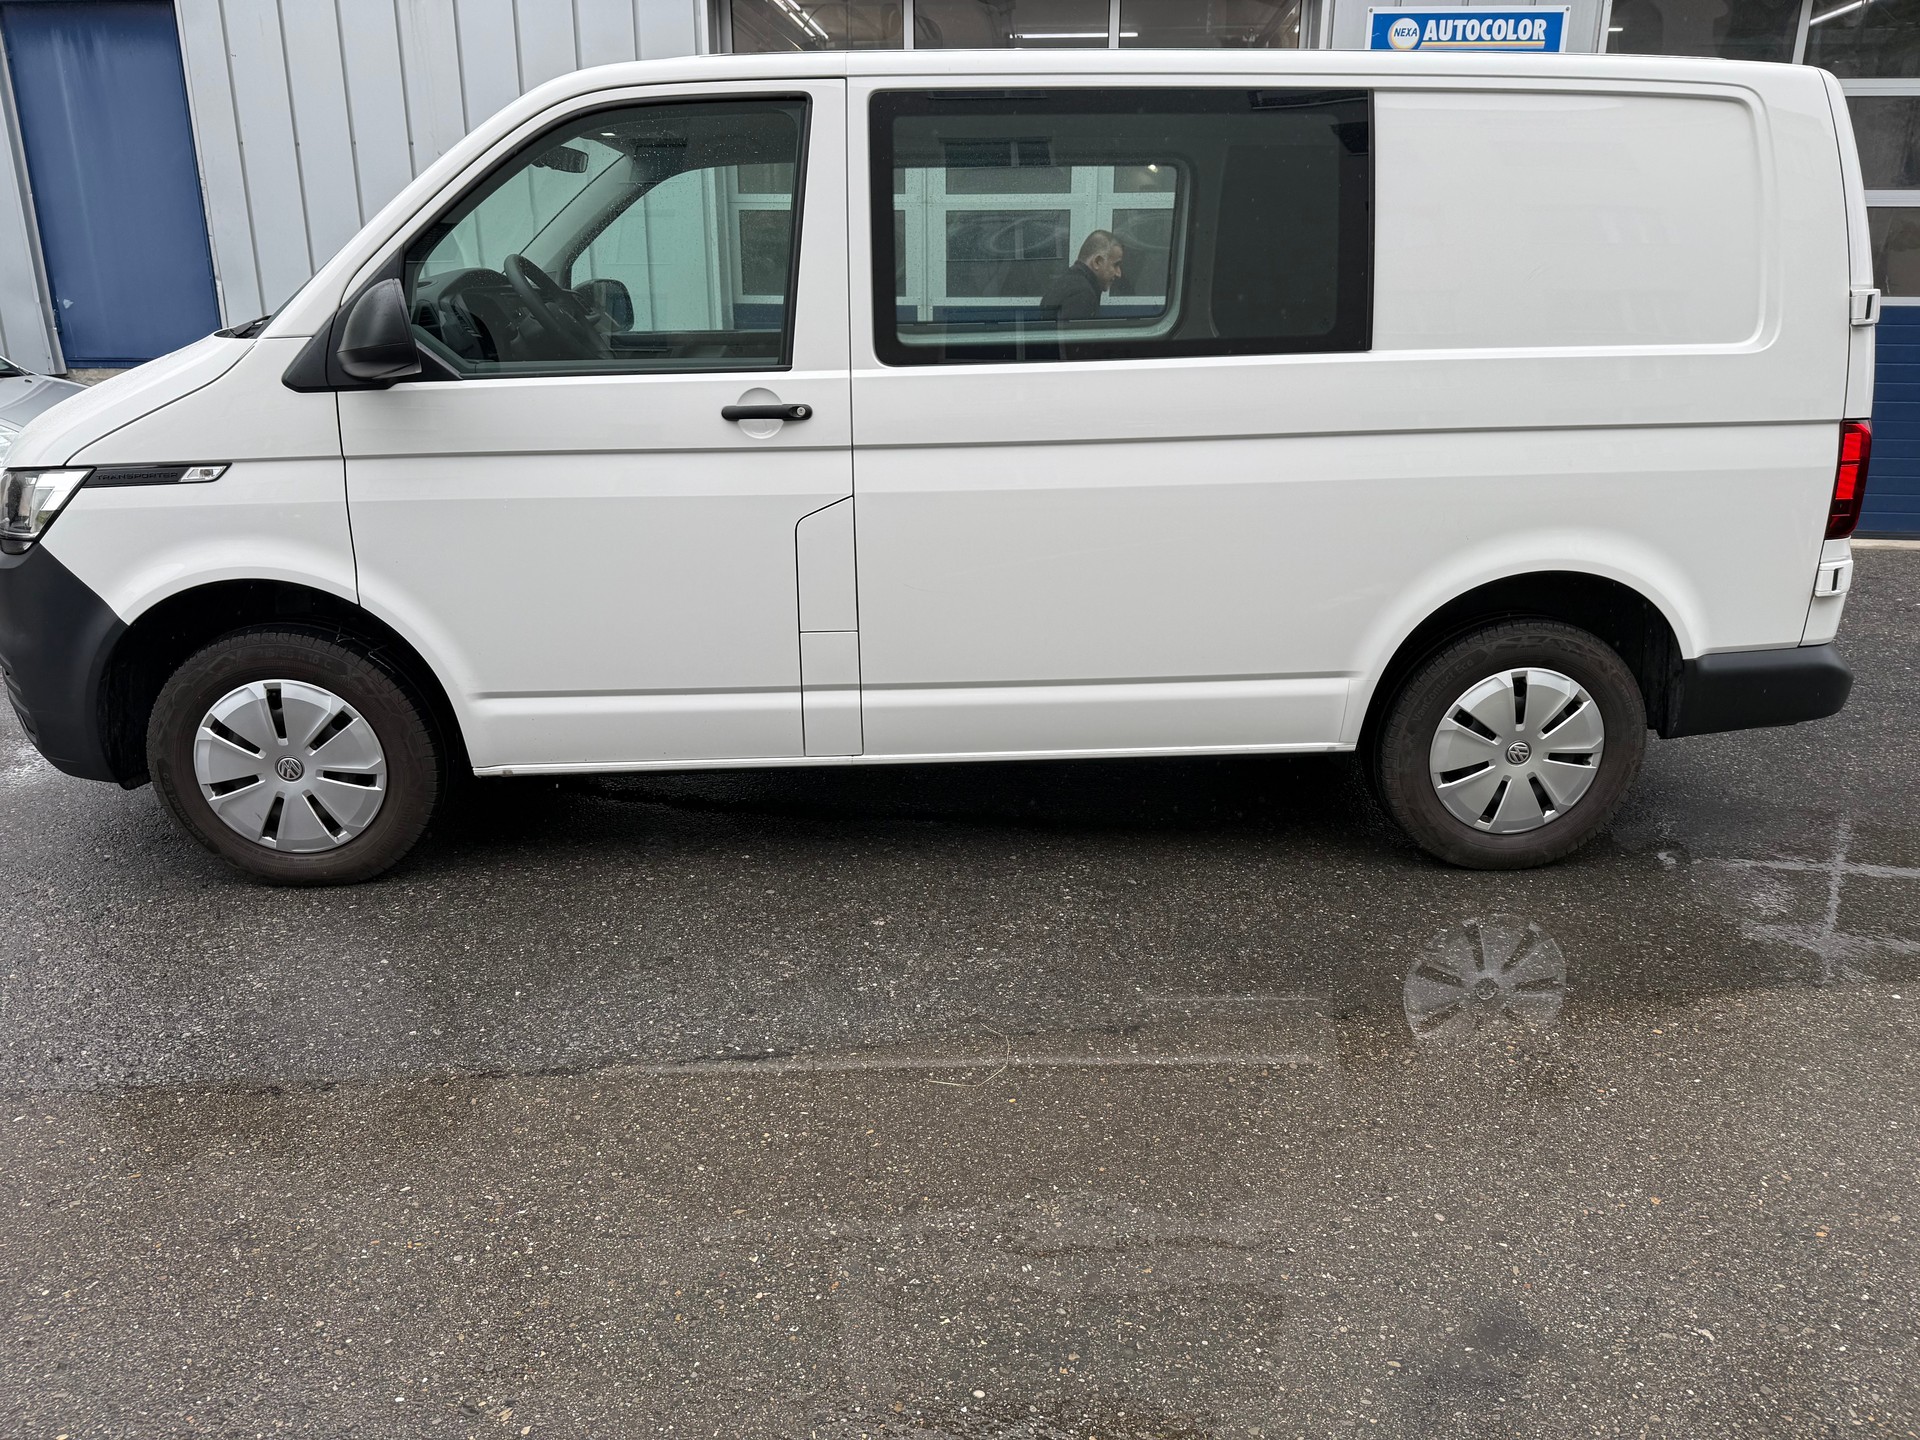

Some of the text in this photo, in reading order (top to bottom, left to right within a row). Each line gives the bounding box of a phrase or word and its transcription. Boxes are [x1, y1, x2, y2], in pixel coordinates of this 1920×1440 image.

[1393, 18, 1547, 41] NEXA AUTOCOLOR
[96, 472, 178, 480] TRANSPORTER
[1412, 670, 1455, 721] VanContact
